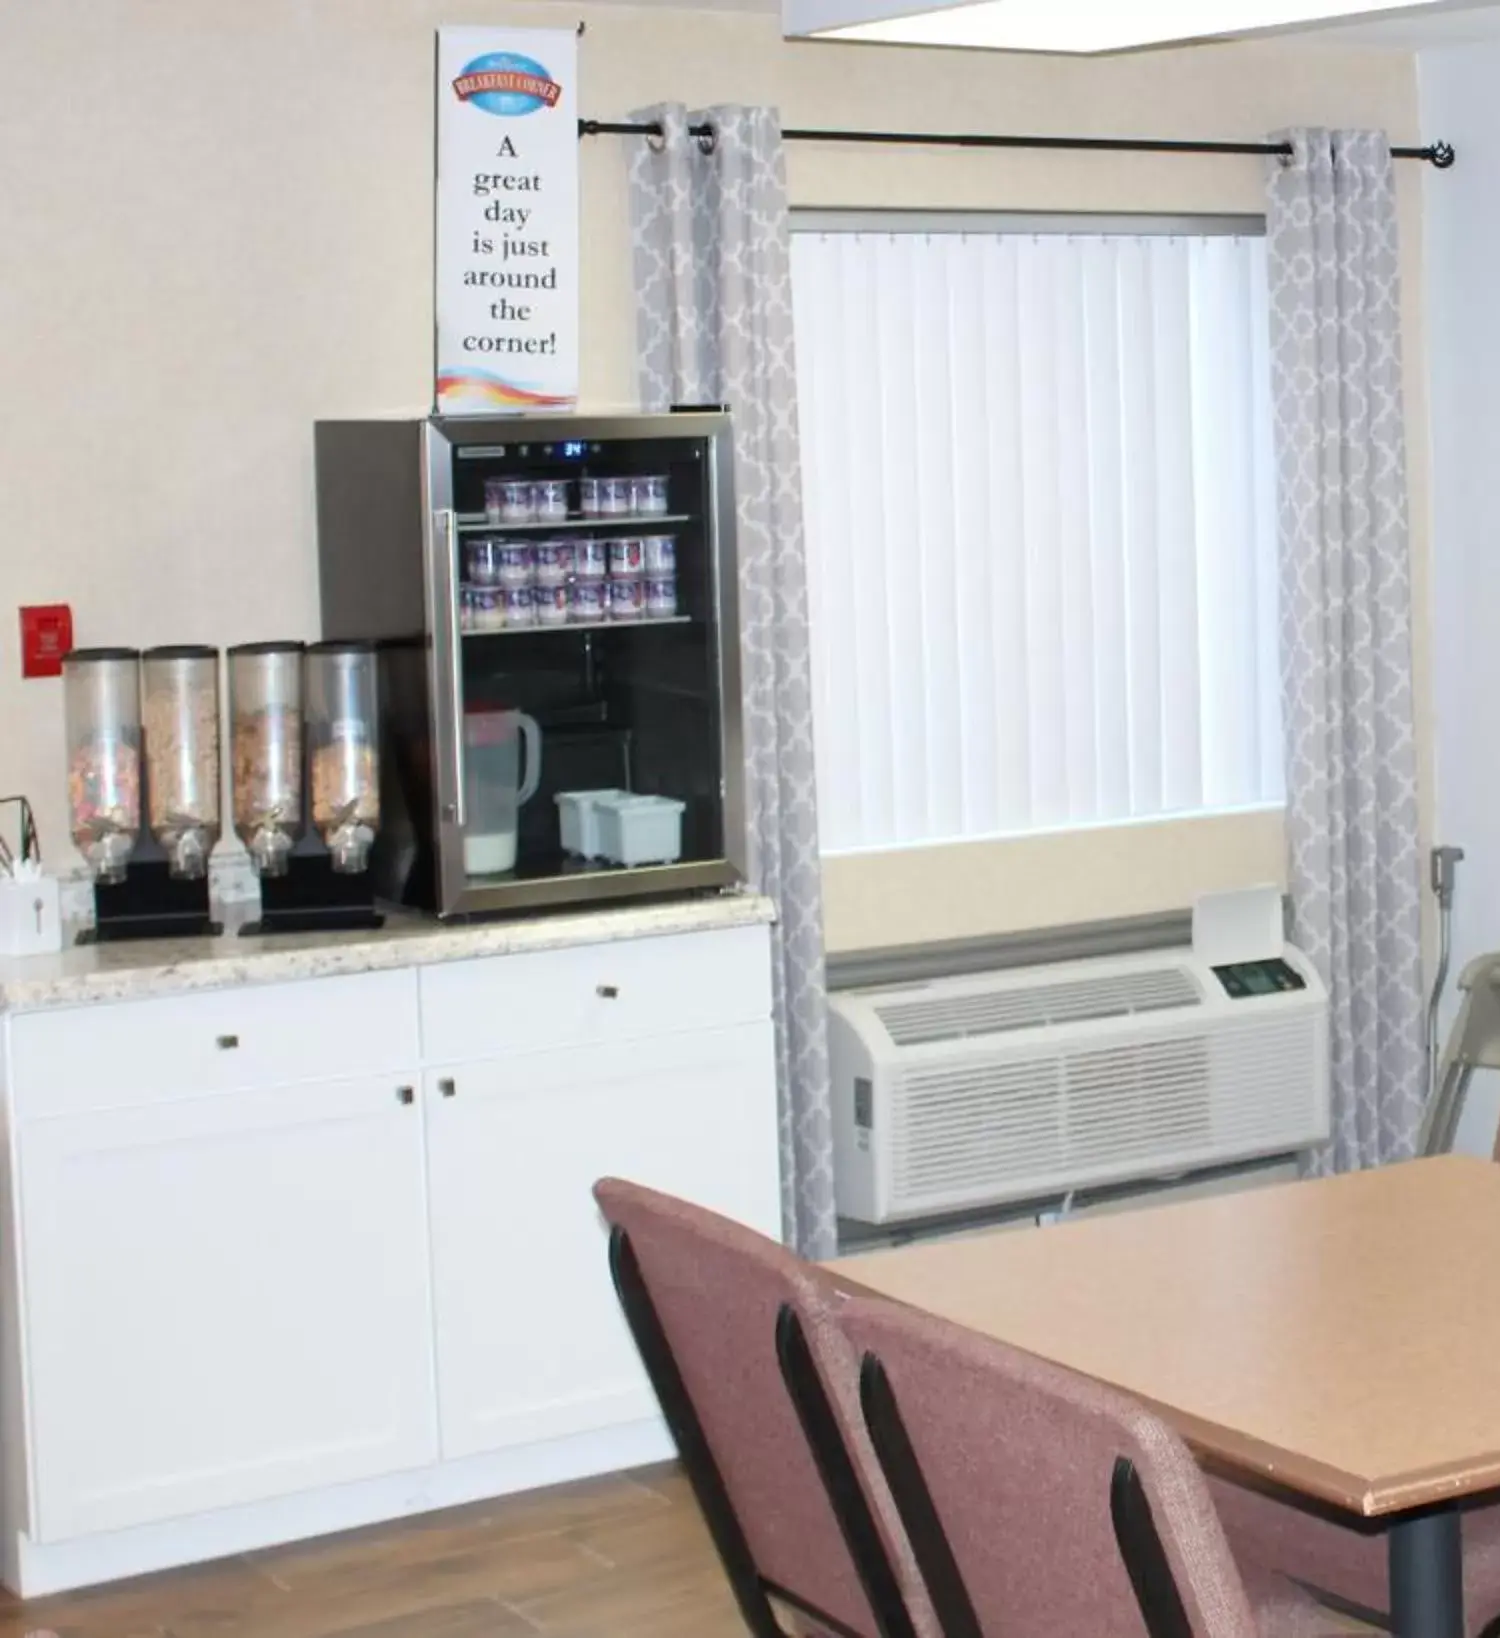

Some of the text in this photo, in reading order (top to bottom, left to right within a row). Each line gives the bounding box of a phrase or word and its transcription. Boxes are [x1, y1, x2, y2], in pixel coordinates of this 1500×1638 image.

[497, 135, 519, 157] A
[473, 172, 542, 195] great
[484, 201, 530, 229] day
[472, 232, 550, 260] is just
[463, 268, 557, 289] around
[490, 299, 531, 321] the
[463, 333, 556, 355] corner!
